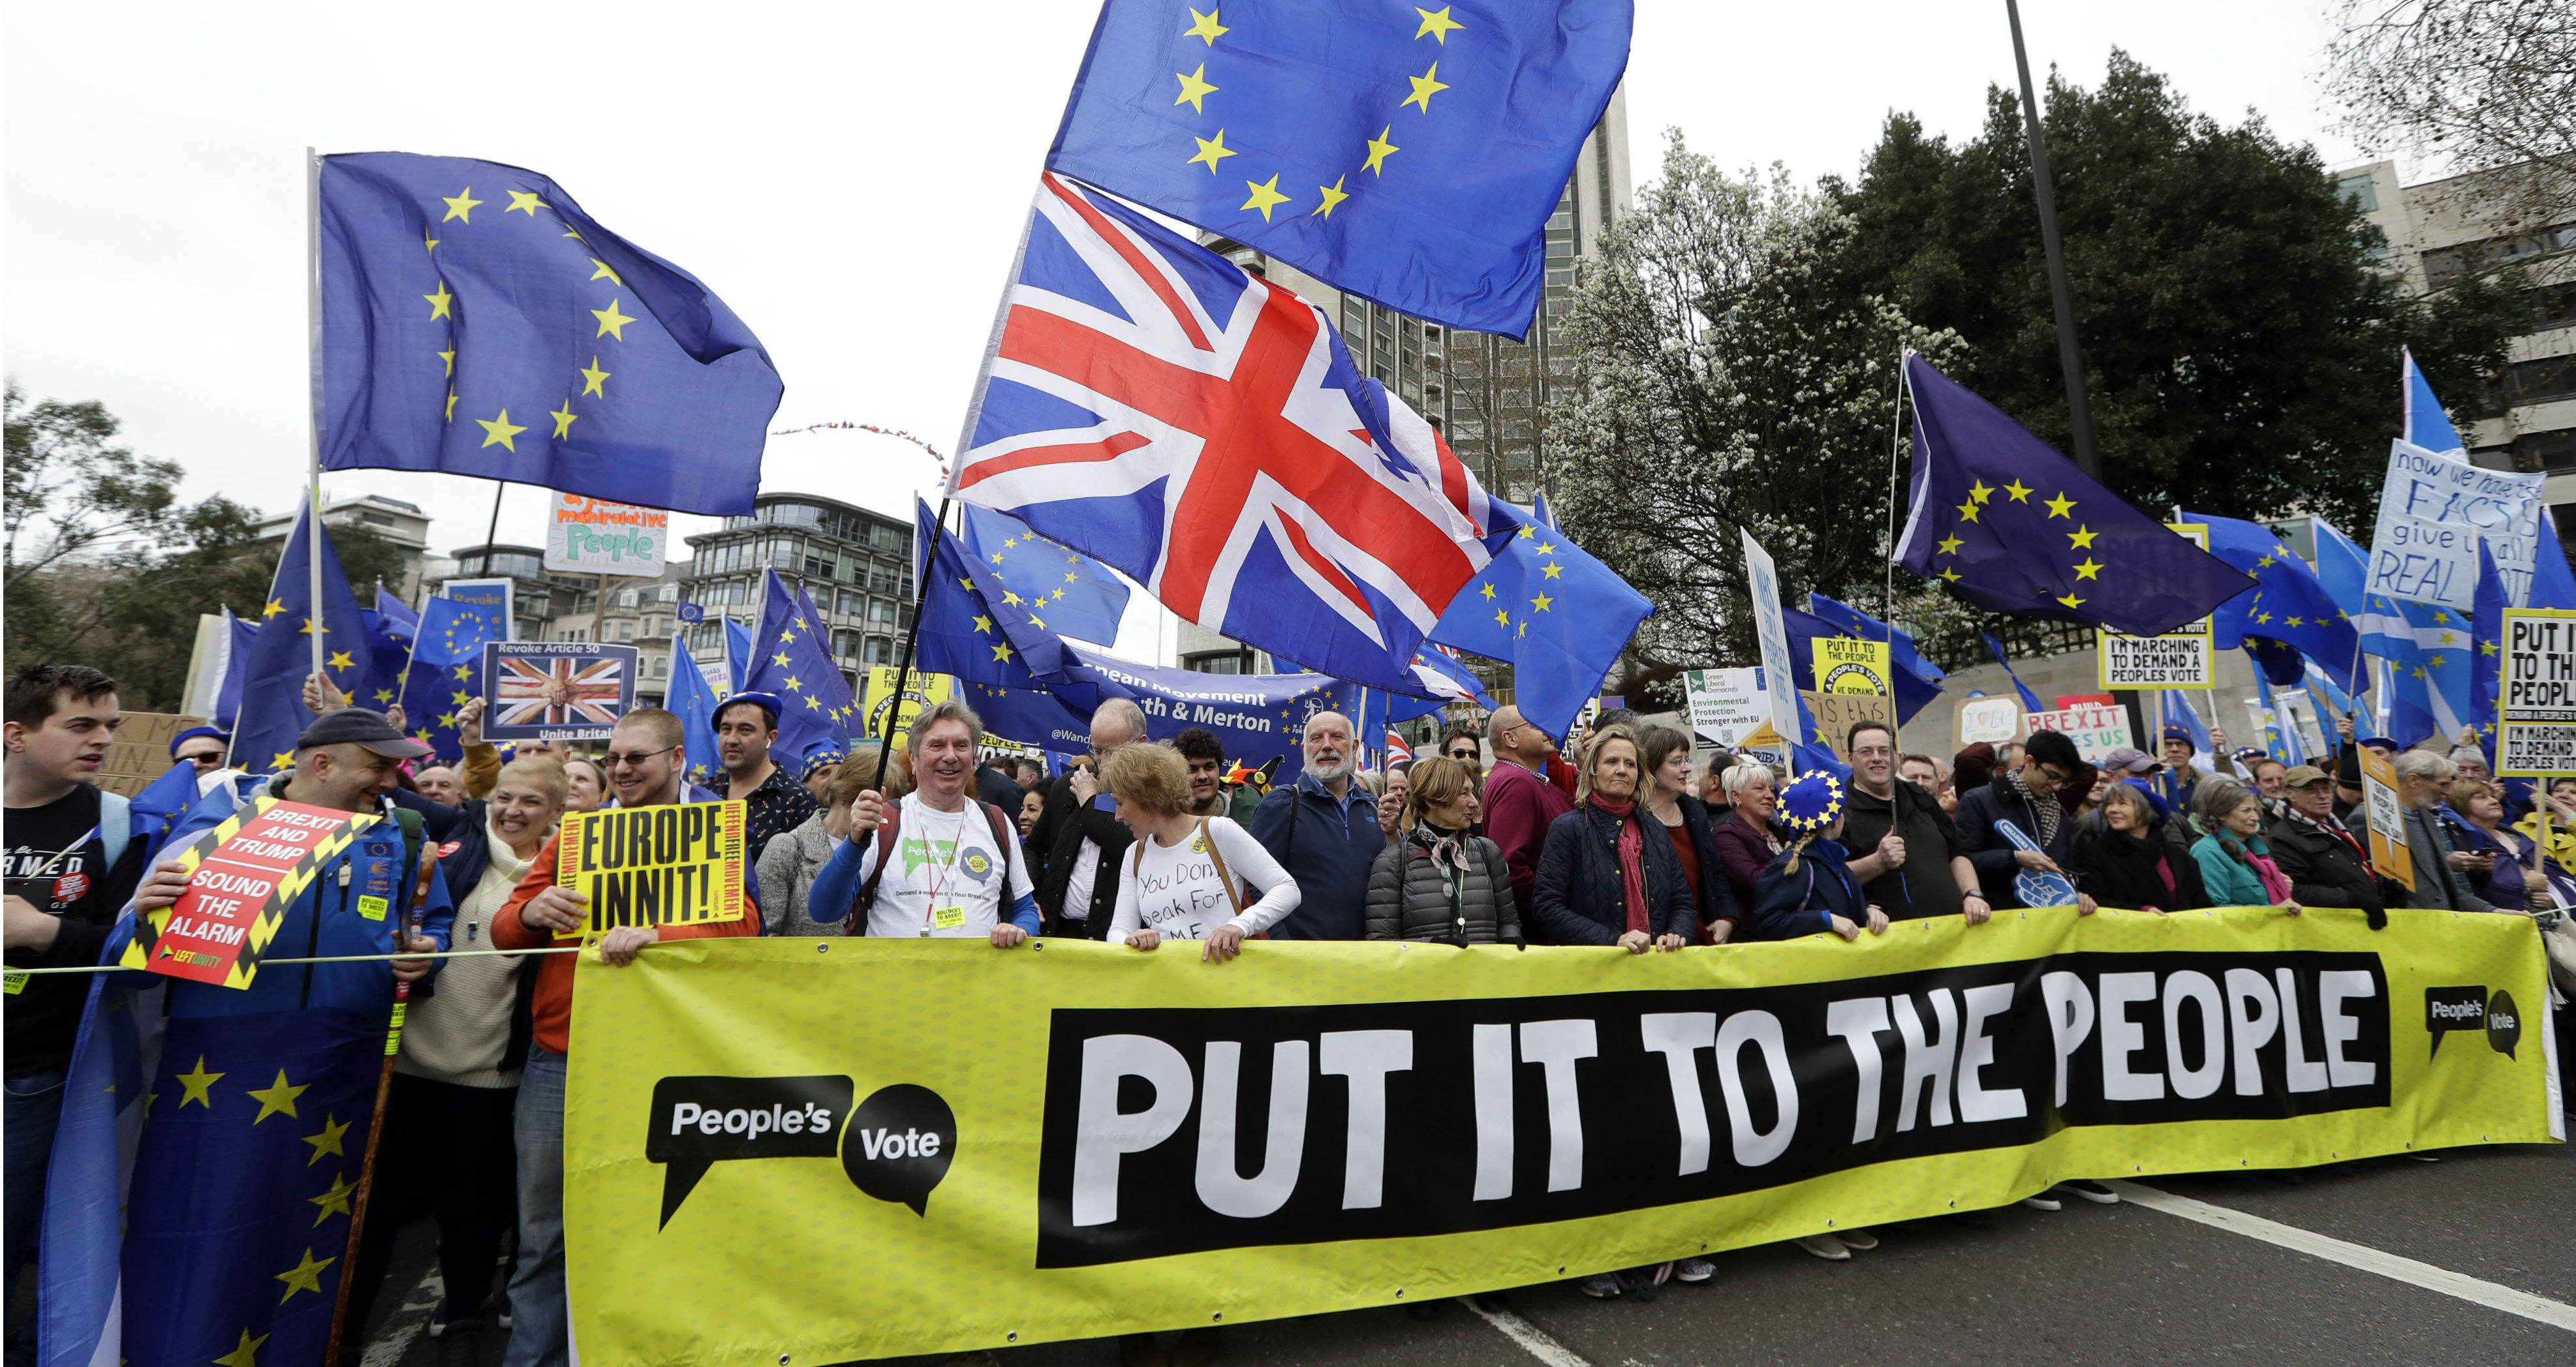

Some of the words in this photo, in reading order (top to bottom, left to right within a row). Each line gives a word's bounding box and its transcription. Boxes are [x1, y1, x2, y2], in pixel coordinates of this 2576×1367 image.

[2397, 453, 2445, 476] now
[567, 524, 653, 562] People
[2393, 521, 2455, 548] give
[2374, 550, 2455, 602] REAL
[498, 643, 542, 653] Revoke
[544, 643, 583, 653] Article
[585, 644, 600, 653] 50
[1827, 639, 1846, 651] PUT
[1850, 641, 1859, 653] IT
[1863, 643, 1875, 653] TO
[2111, 639, 2128, 653] I'M
[2132, 639, 2199, 653] MARCHING
[2513, 622, 2558, 652] PUT
[1828, 651, 1842, 660] THE
[1846, 653, 1876, 662] PEOPLE
[2111, 654, 2128, 668] TO
[2133, 654, 2186, 668] DEMAND
[2192, 654, 2201, 668] A
[2511, 653, 2537, 680] TO
[2547, 653, 2576, 681] TH
[884, 669, 899, 680] PU
[1828, 664, 1865, 684] PEOPLE'S
[1866, 670, 1885, 694] VOTE
[2112, 669, 2166, 682] PEOPLES
[2171, 669, 2201, 681] VOTE
[1153, 683, 1267, 707] Movement
[1692, 697, 1750, 707] Environmental
[1837, 686, 1846, 694] WE
[1848, 687, 1874, 696] DEMAND
[2510, 681, 2576, 706] PEOPL
[1172, 701, 1190, 721] &
[1193, 704, 1271, 733] Merton
[1694, 707, 1736, 716] Protection
[1696, 718, 1730, 727] Stronger
[1731, 715, 1749, 724] with
[2028, 707, 2120, 735] BREXIT
[539, 728, 574, 739] Unite
[1051, 729, 1091, 745] @Wand
[2100, 730, 2125, 746] US
[2527, 727, 2576, 741] MARCHIN
[2508, 741, 2523, 756] TO
[2527, 741, 2573, 756] DEMAND
[2507, 757, 2554, 769] PEOPLES
[262, 808, 345, 831] BREXIT
[258, 826, 309, 842] AND
[582, 805, 721, 872] EUROPE
[228, 837, 306, 861] TRUMP
[3, 856, 84, 876] RMED
[191, 870, 272, 898] SOUND
[196, 894, 242, 919] THE
[591, 864, 709, 931] INNIT!
[1190, 889, 1224, 912] For
[937, 907, 961, 916] BOLLOCKS
[165, 915, 246, 946] ALARM
[2431, 1000, 2483, 1021] People's
[2489, 1013, 2515, 1030] Vote
[1072, 1030, 1414, 1227] PUT
[1472, 1018, 1597, 1203] IT
[1641, 1009, 1800, 1177] TO
[1827, 982, 2027, 1144] THE
[2040, 966, 2377, 1108] PEOPLE
[671, 1101, 832, 1139] People's
[860, 1127, 941, 1161] Vote
